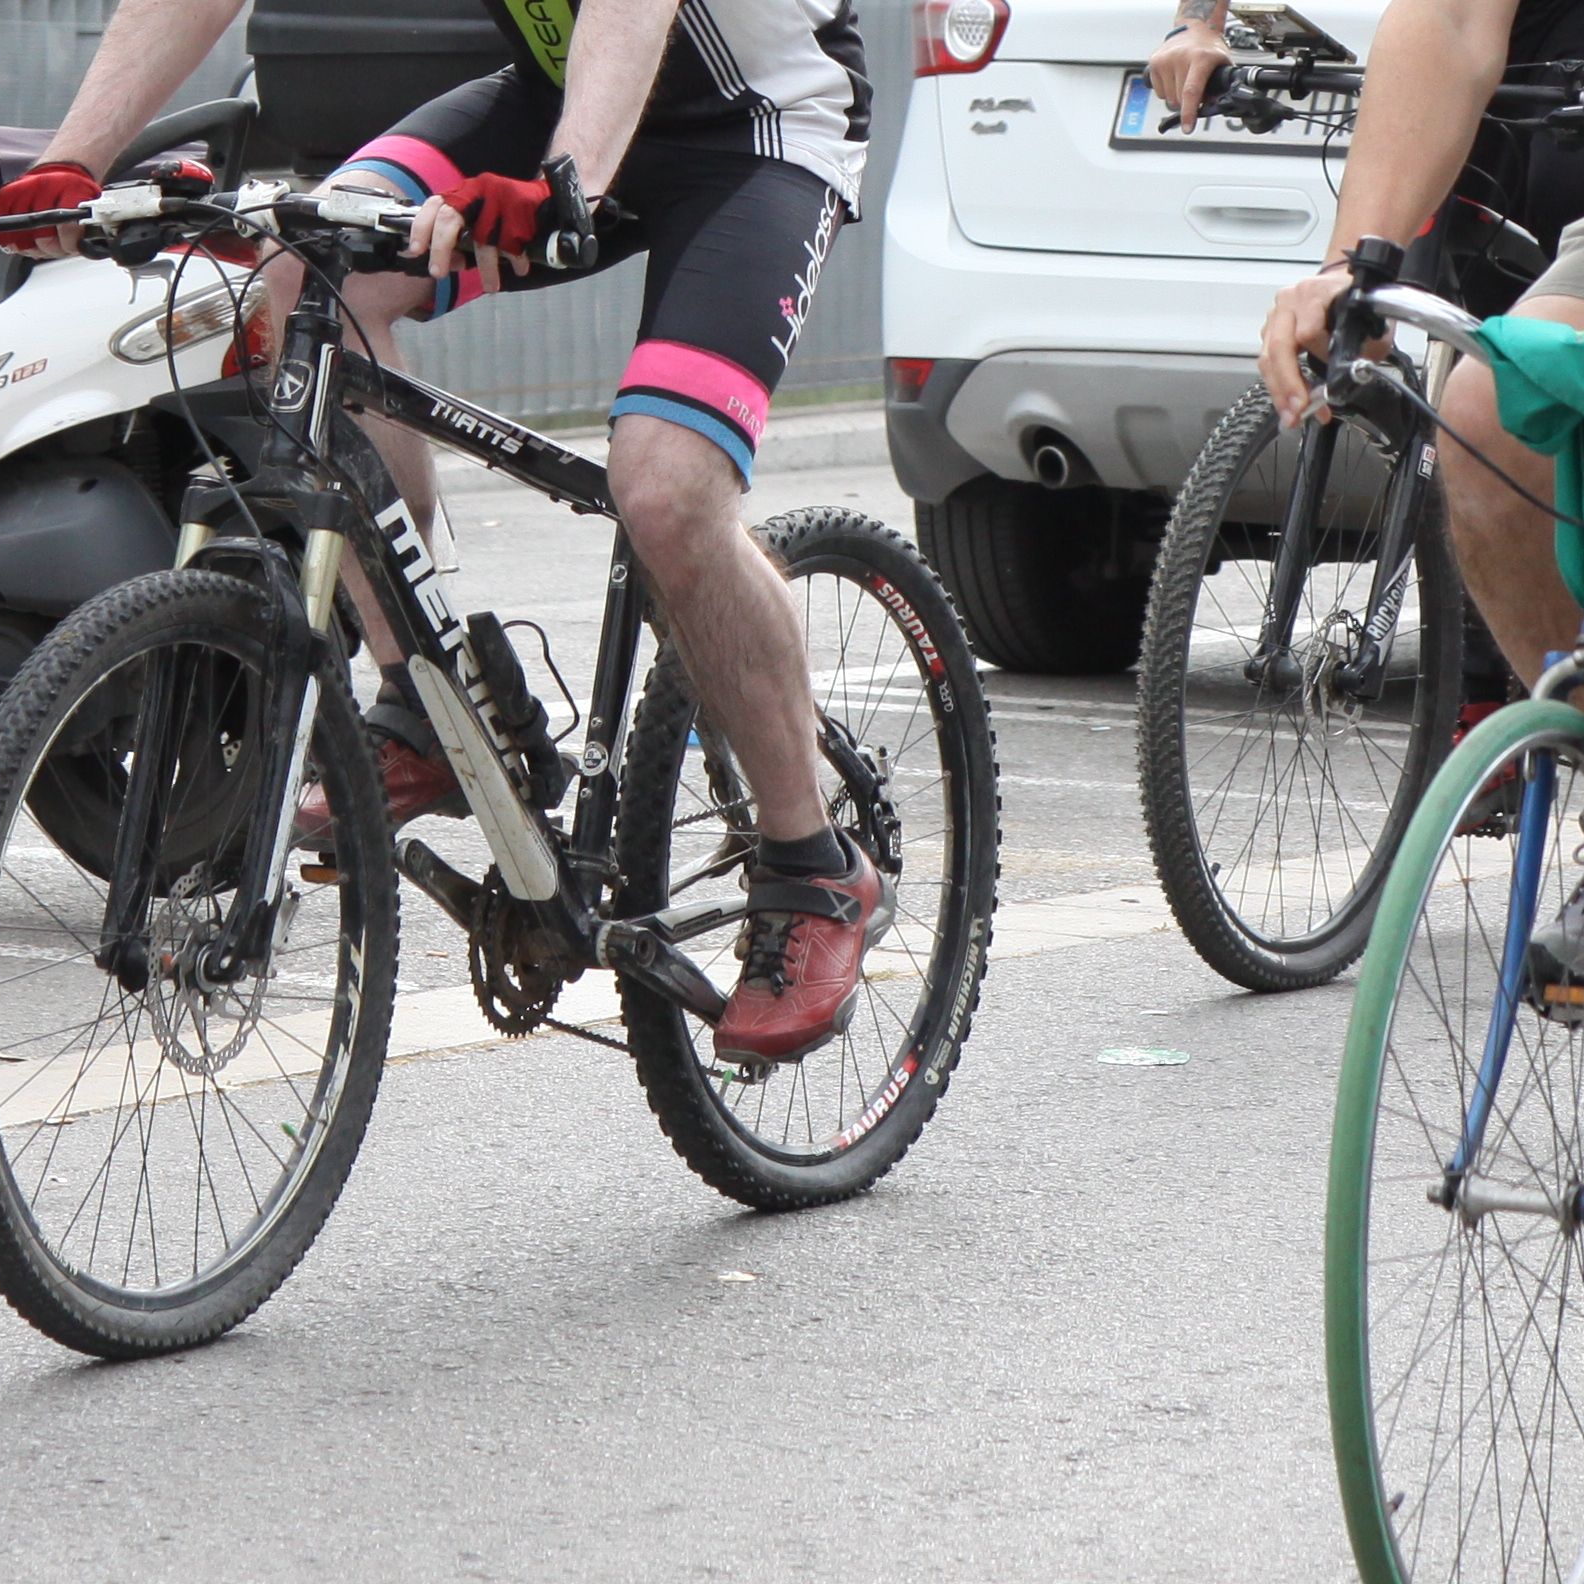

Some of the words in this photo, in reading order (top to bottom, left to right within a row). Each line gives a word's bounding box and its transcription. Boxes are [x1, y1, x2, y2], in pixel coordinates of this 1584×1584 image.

[878, 582, 938, 666] TAURUS
[947, 942, 981, 1041] MICHELIN
[841, 1068, 910, 1145] TAURUS
